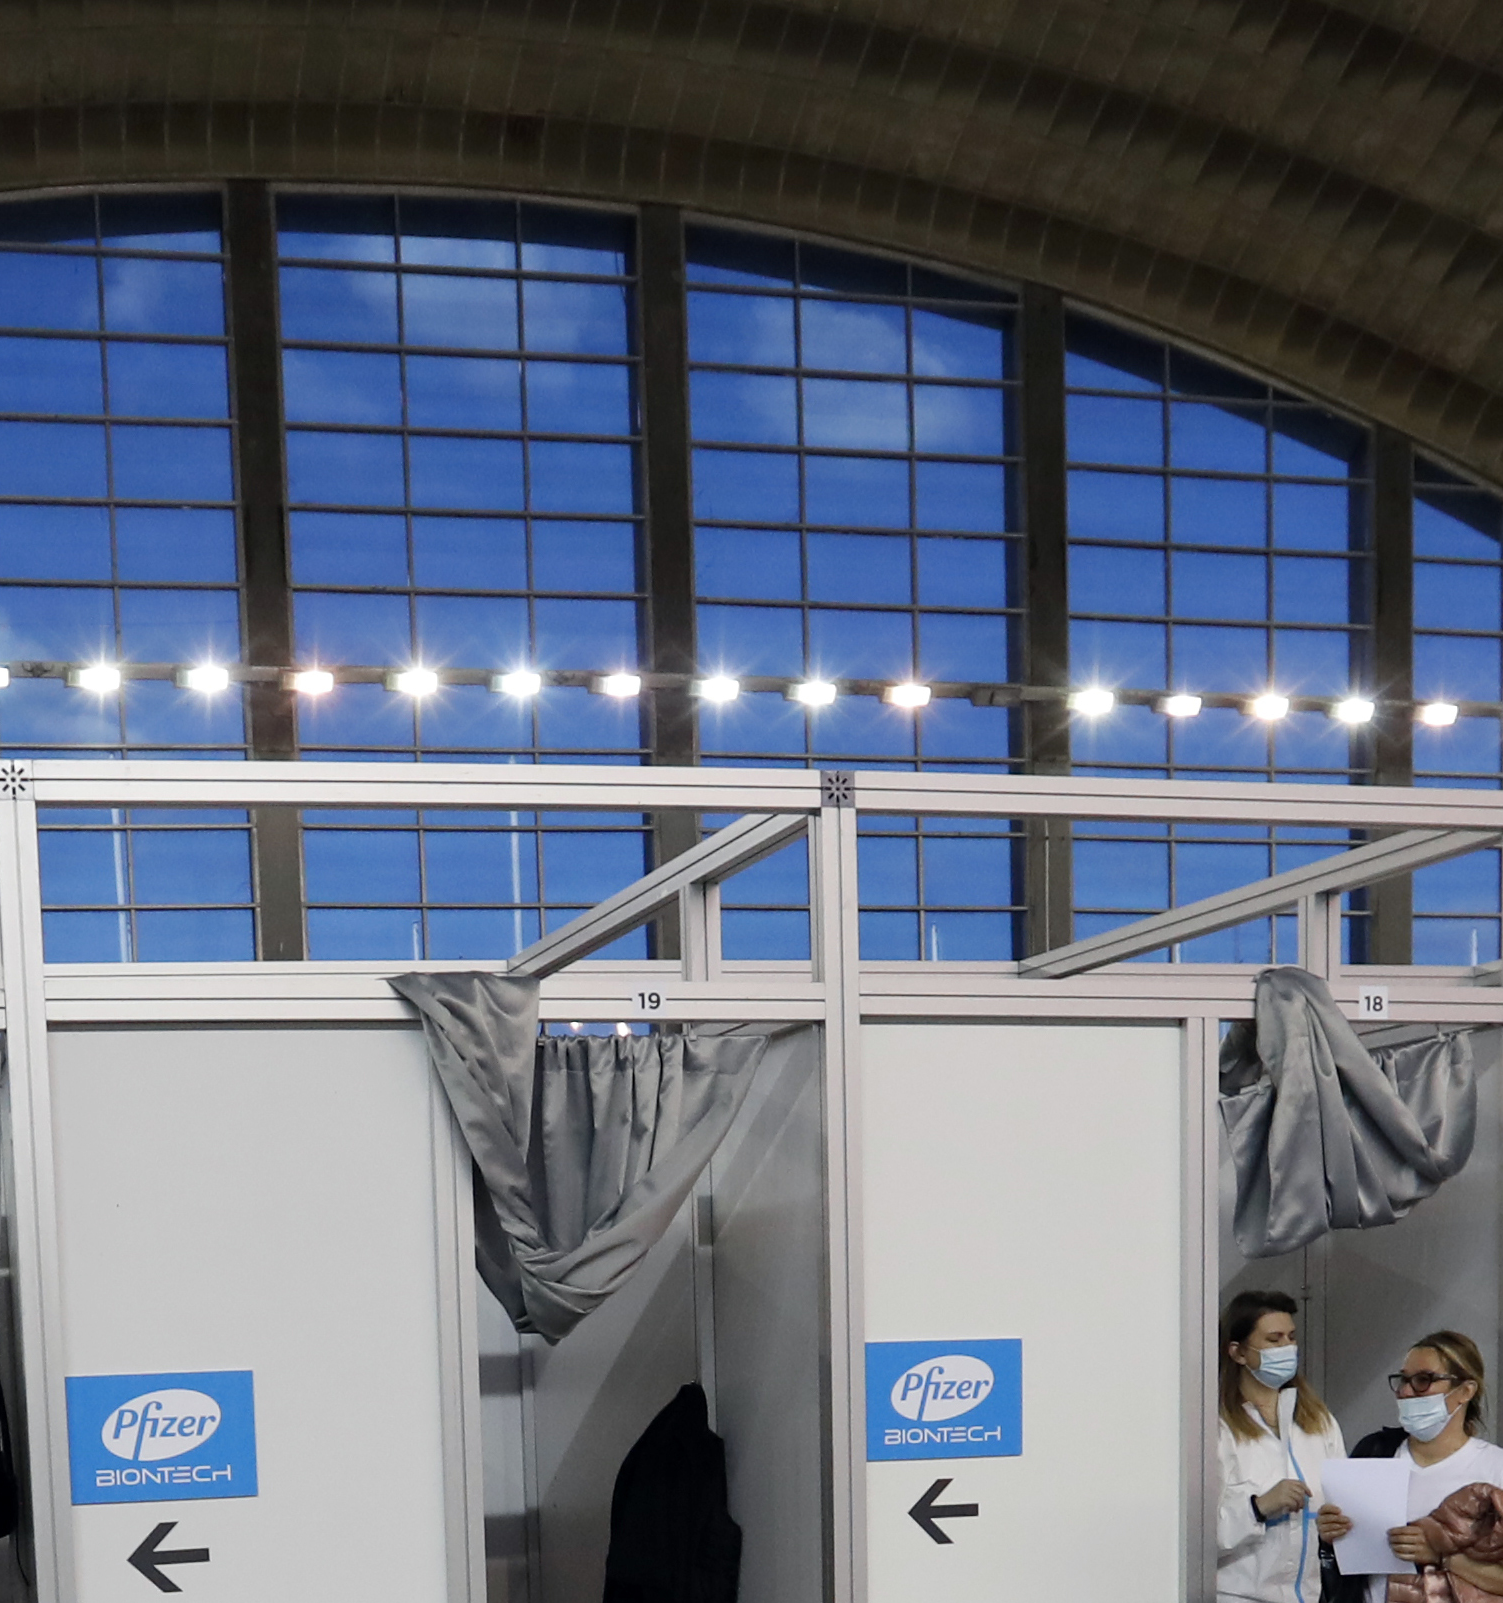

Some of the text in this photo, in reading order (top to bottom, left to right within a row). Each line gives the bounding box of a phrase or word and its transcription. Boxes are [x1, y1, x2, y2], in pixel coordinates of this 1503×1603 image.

[637, 992, 661, 1009] 19
[1364, 996, 1383, 1011] 18
[900, 1365, 990, 1421] Pfizer
[113, 1401, 216, 1460] Pfizer
[884, 1425, 1001, 1445] BIONTECH
[96, 1464, 232, 1487] BIONTECH
